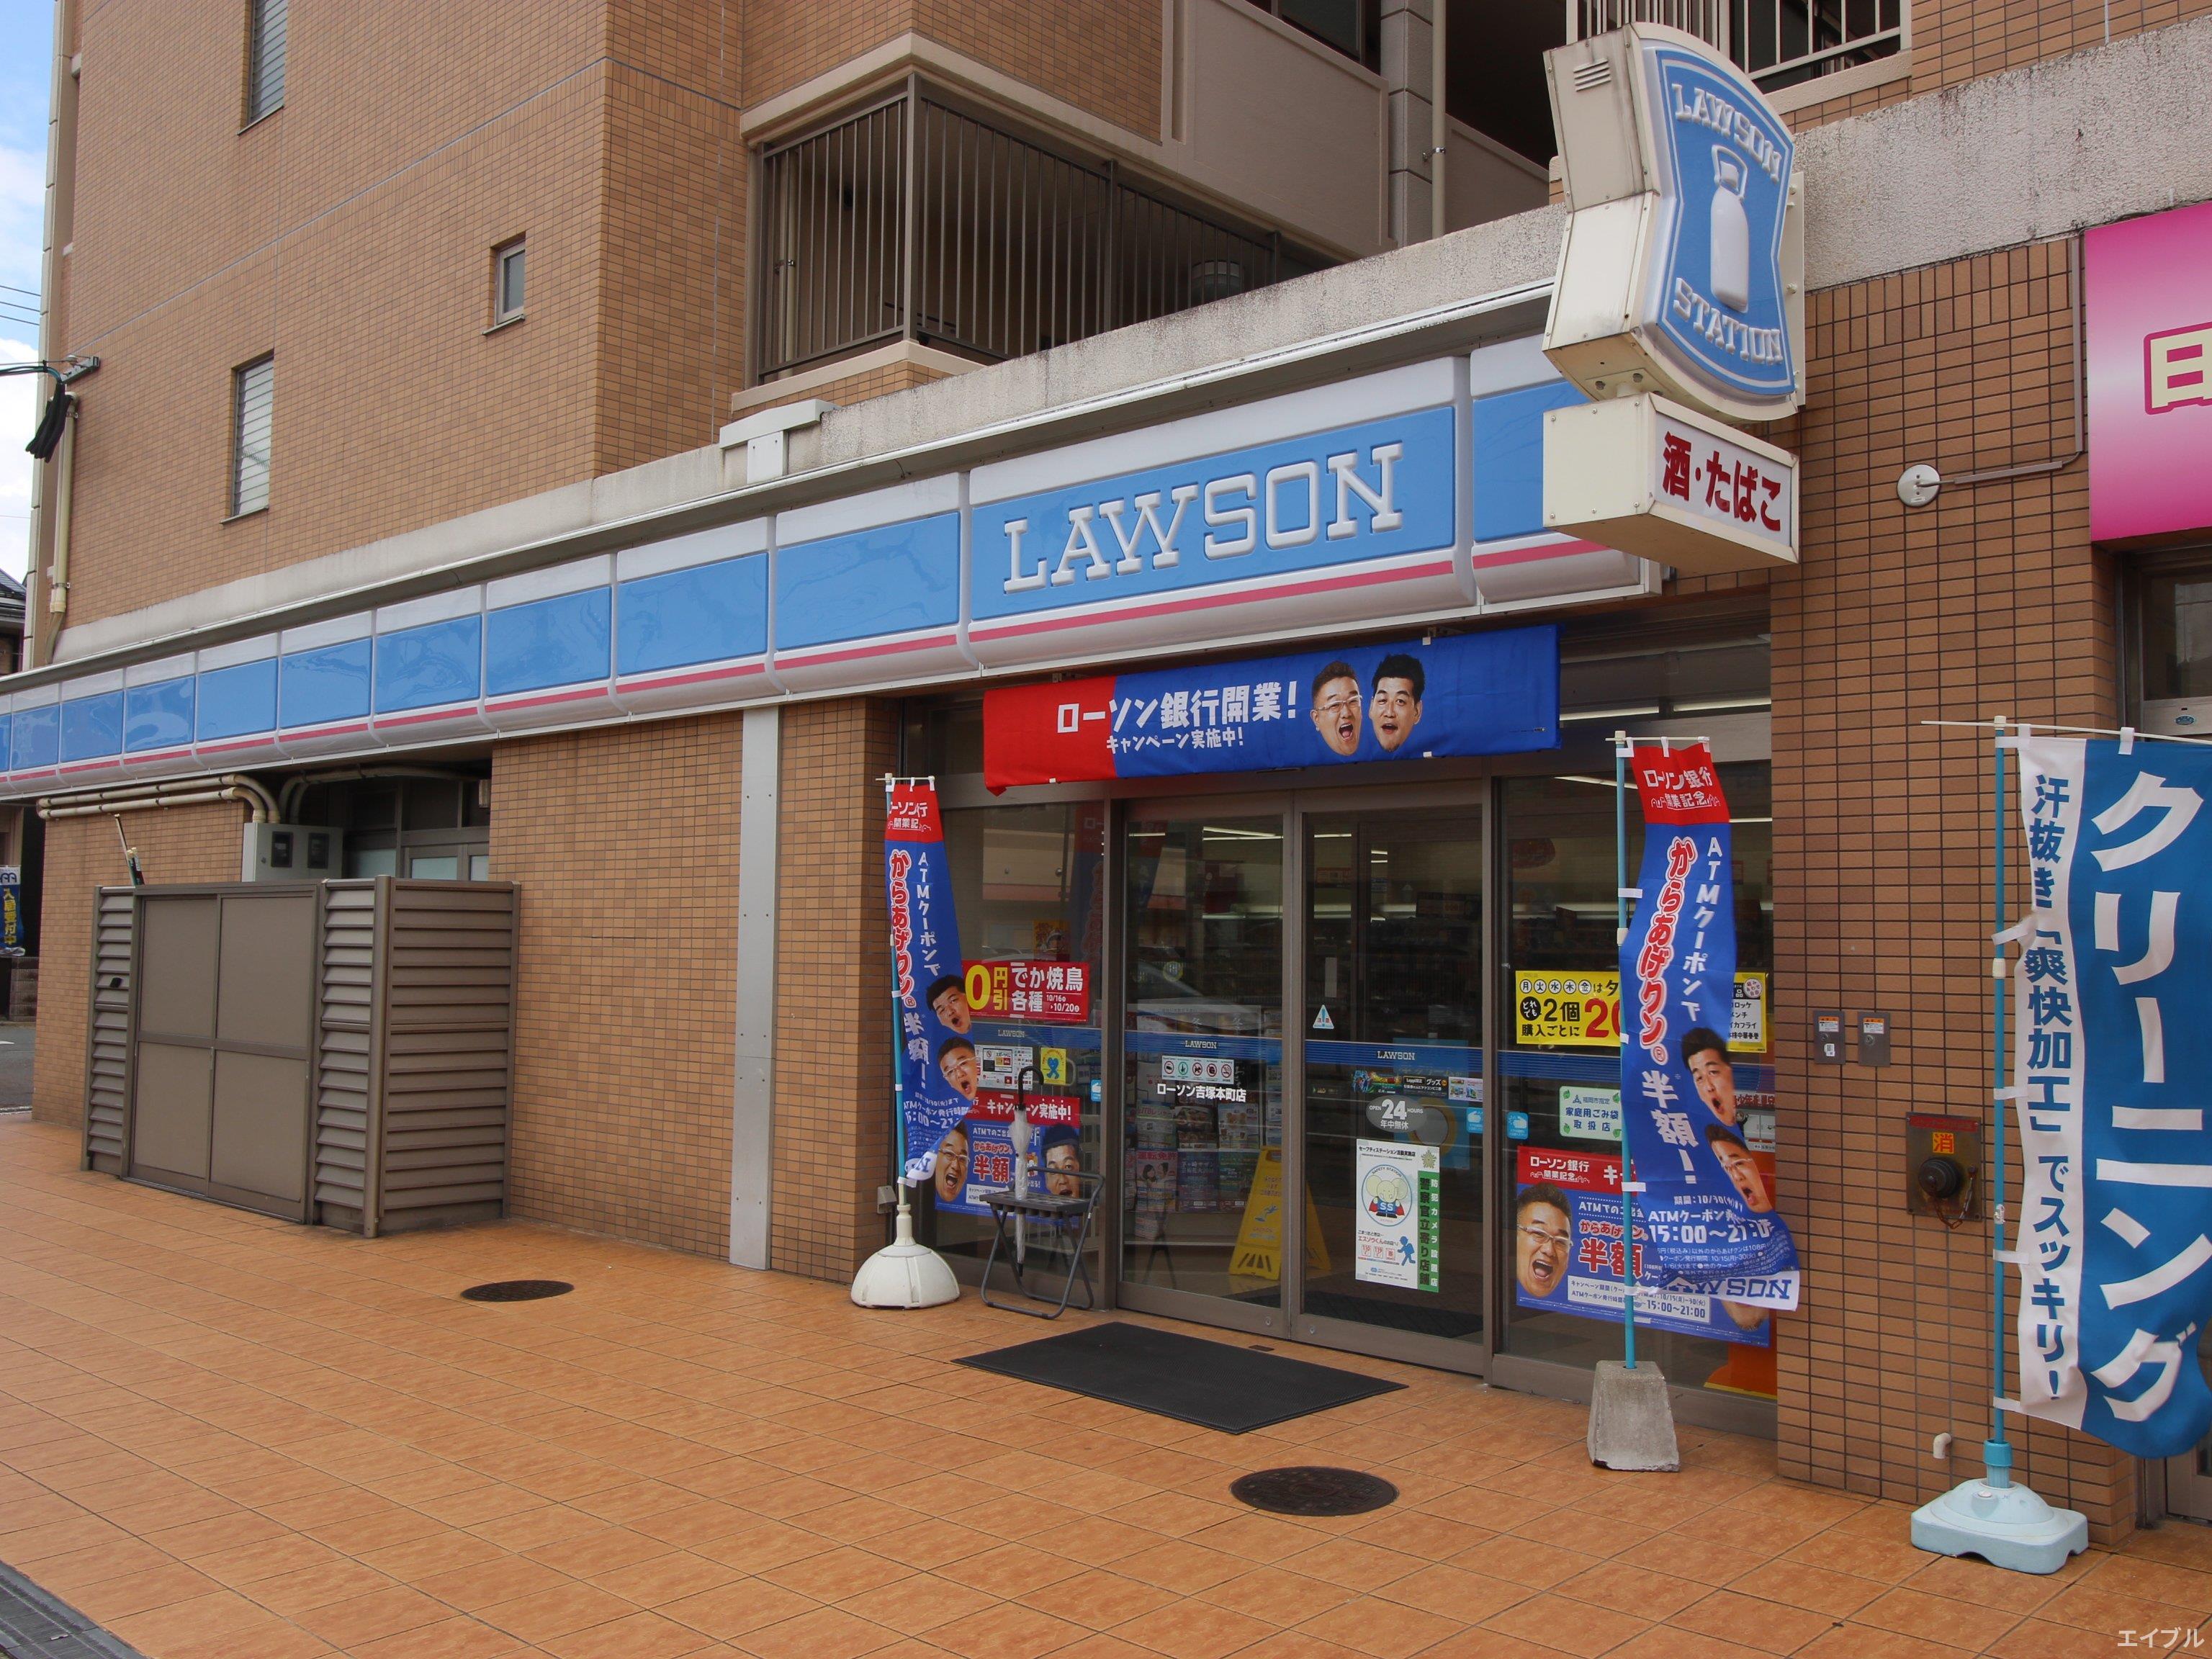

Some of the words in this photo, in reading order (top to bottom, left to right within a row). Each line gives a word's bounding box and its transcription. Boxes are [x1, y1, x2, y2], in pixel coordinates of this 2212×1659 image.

[1671, 83, 1782, 184] LAWSON
[1673, 277, 1784, 366] STATION
[1663, 431, 1781, 532] 酒・たばこ
[1004, 441, 1403, 595] LAWSON
[1058, 680, 1297, 734] ローソン銀行開業!
[1106, 727, 1244, 755] キャンペーン実施中!
[1681, 837, 1723, 1022] ATMクーポンで
[1184, 1040, 1218, 1049] LAWSON
[1521, 1023, 1580, 1038] 購入ごとに
[1377, 1051, 1416, 1061] LAWSON
[1156, 1083, 1247, 1103] ローソン吉塚本町店
[2090, 770, 2212, 1424] クリーニング
[1381, 1098, 1408, 1120] 24
[1565, 1107, 1619, 1120] 家庭用ごみ袋
[1380, 1120, 1409, 1130] 年中無休
[973, 1154, 1010, 1184] 半額
[1530, 1156, 1590, 1173] ローソン銀行
[1380, 1202, 1394, 1211] SS
[1578, 1237, 1643, 1279] 半額
